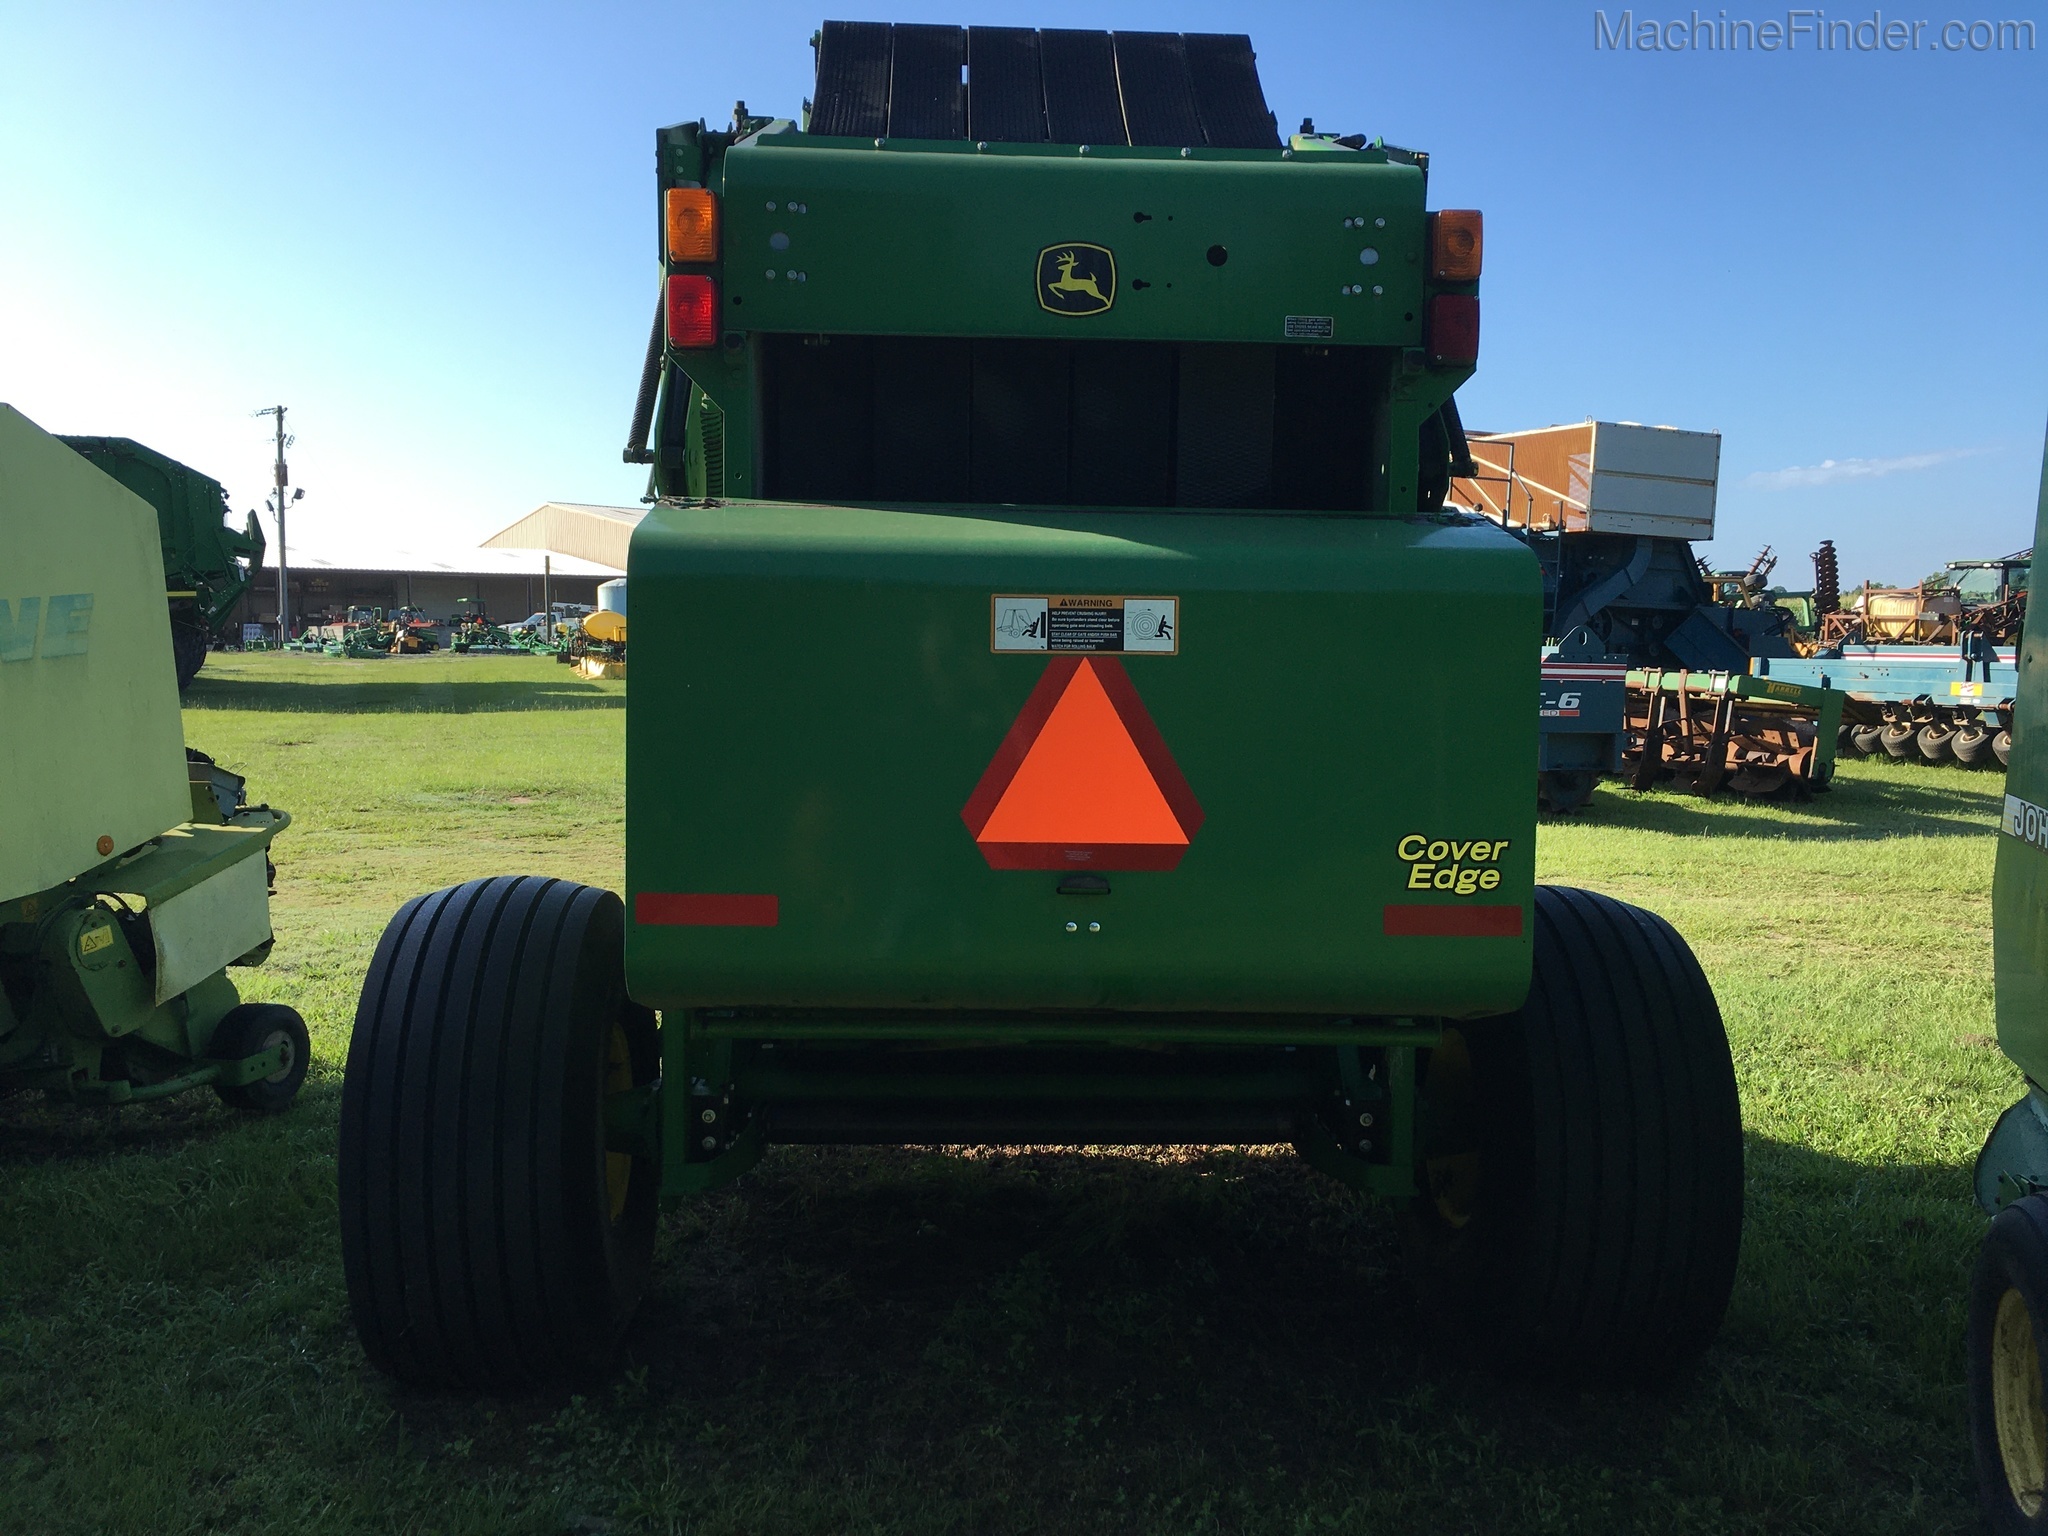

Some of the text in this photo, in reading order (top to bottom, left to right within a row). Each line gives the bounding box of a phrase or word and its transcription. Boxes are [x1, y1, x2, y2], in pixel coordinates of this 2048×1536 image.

[1068, 599, 1112, 607] WARNING
[1396, 833, 1510, 863] Cover
[1407, 863, 1502, 896] Edge
